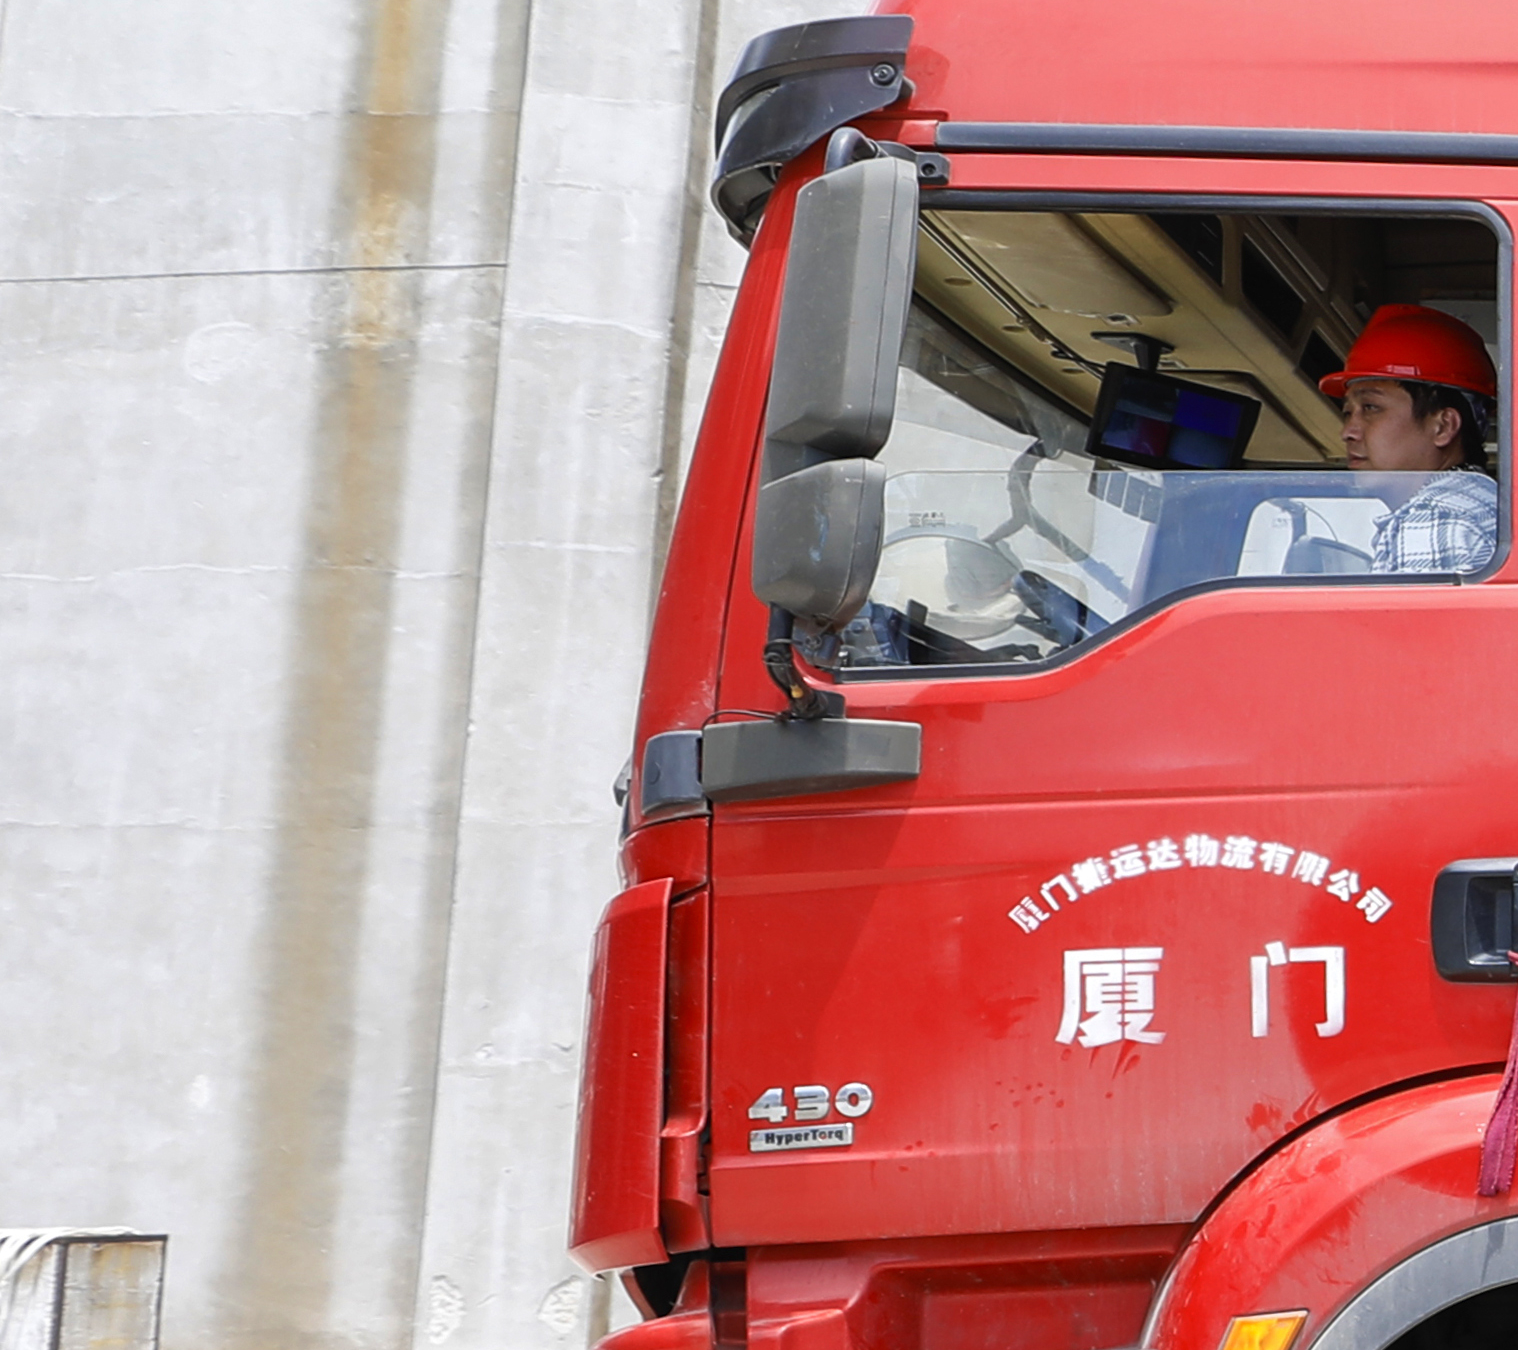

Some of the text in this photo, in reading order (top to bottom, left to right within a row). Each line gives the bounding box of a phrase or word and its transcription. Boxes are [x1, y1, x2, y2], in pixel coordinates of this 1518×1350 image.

[1055, 940, 1345, 1048] 厦门
[748, 1082, 873, 1123] 430
[764, 1128, 844, 1145] HyperTorq
